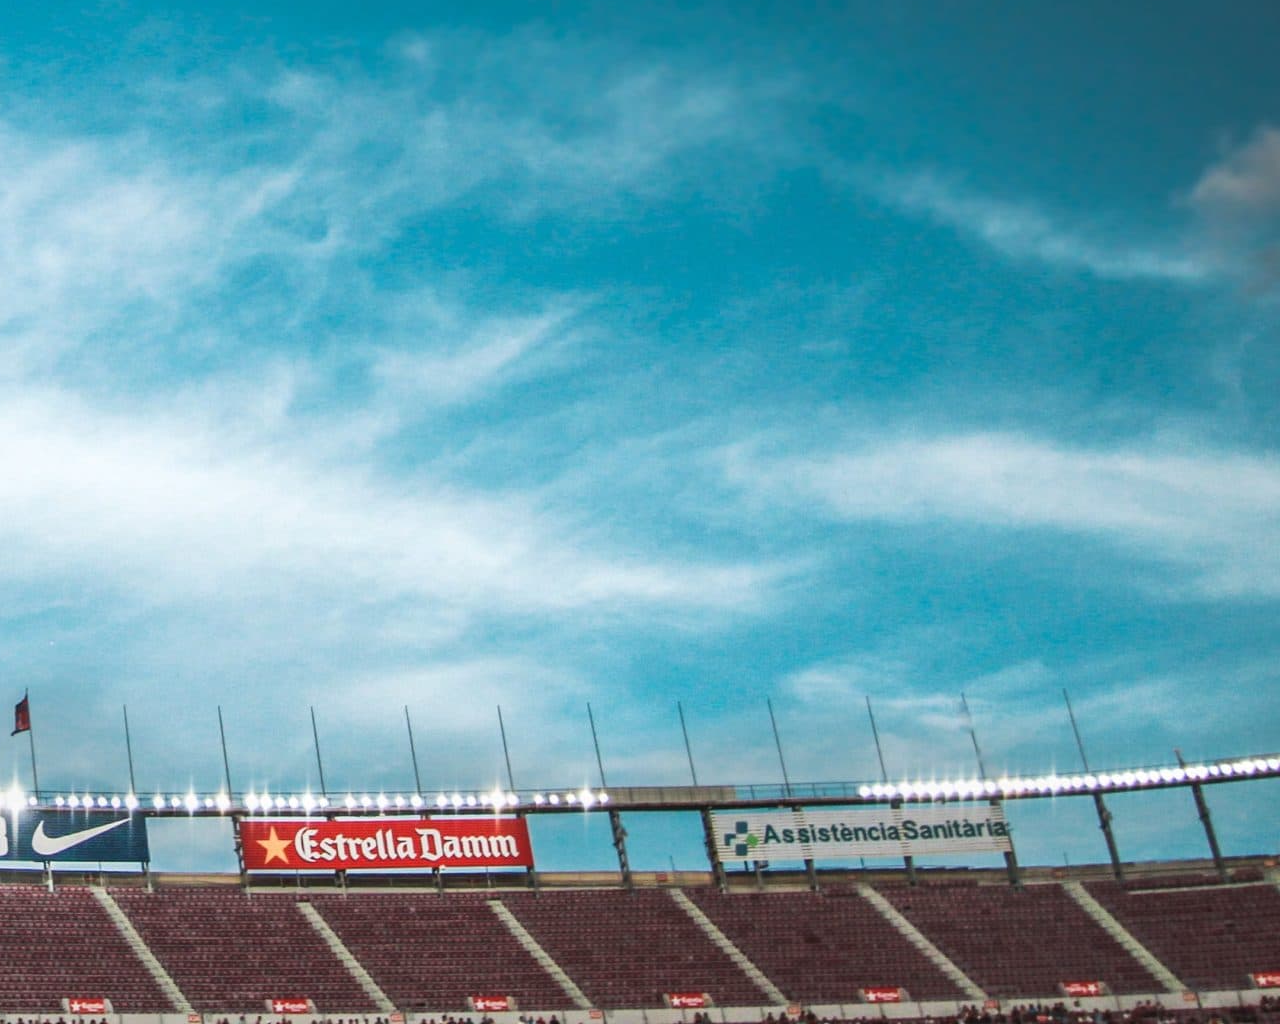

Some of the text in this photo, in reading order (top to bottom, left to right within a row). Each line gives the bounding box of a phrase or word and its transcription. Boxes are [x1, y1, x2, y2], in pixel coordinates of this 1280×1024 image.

[295, 826, 520, 863] Estrella Damm
[763, 817, 1009, 844] Assistència Sanitària
